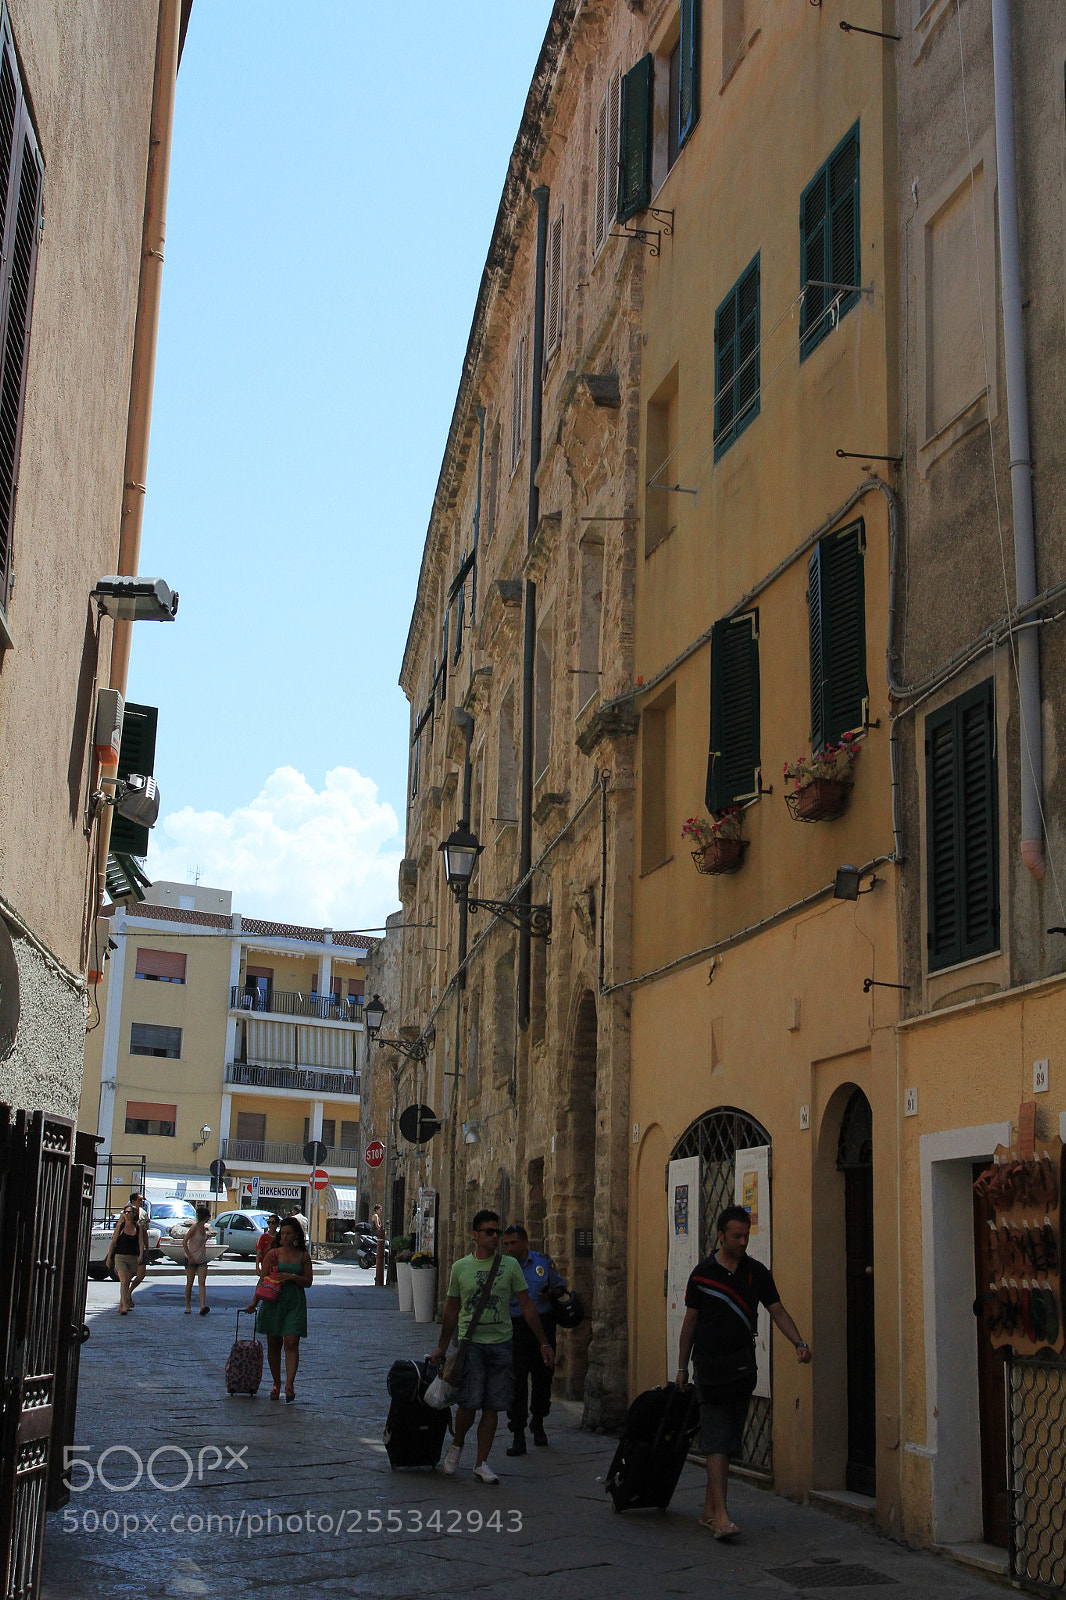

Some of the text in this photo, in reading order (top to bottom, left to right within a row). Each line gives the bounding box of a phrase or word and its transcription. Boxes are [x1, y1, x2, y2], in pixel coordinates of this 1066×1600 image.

[1036, 1072, 1045, 1086] 89
[907, 1098, 914, 1111] 91
[366, 1148, 384, 1160] STOP
[259, 1186, 299, 1197] BIRKENSTOCK
